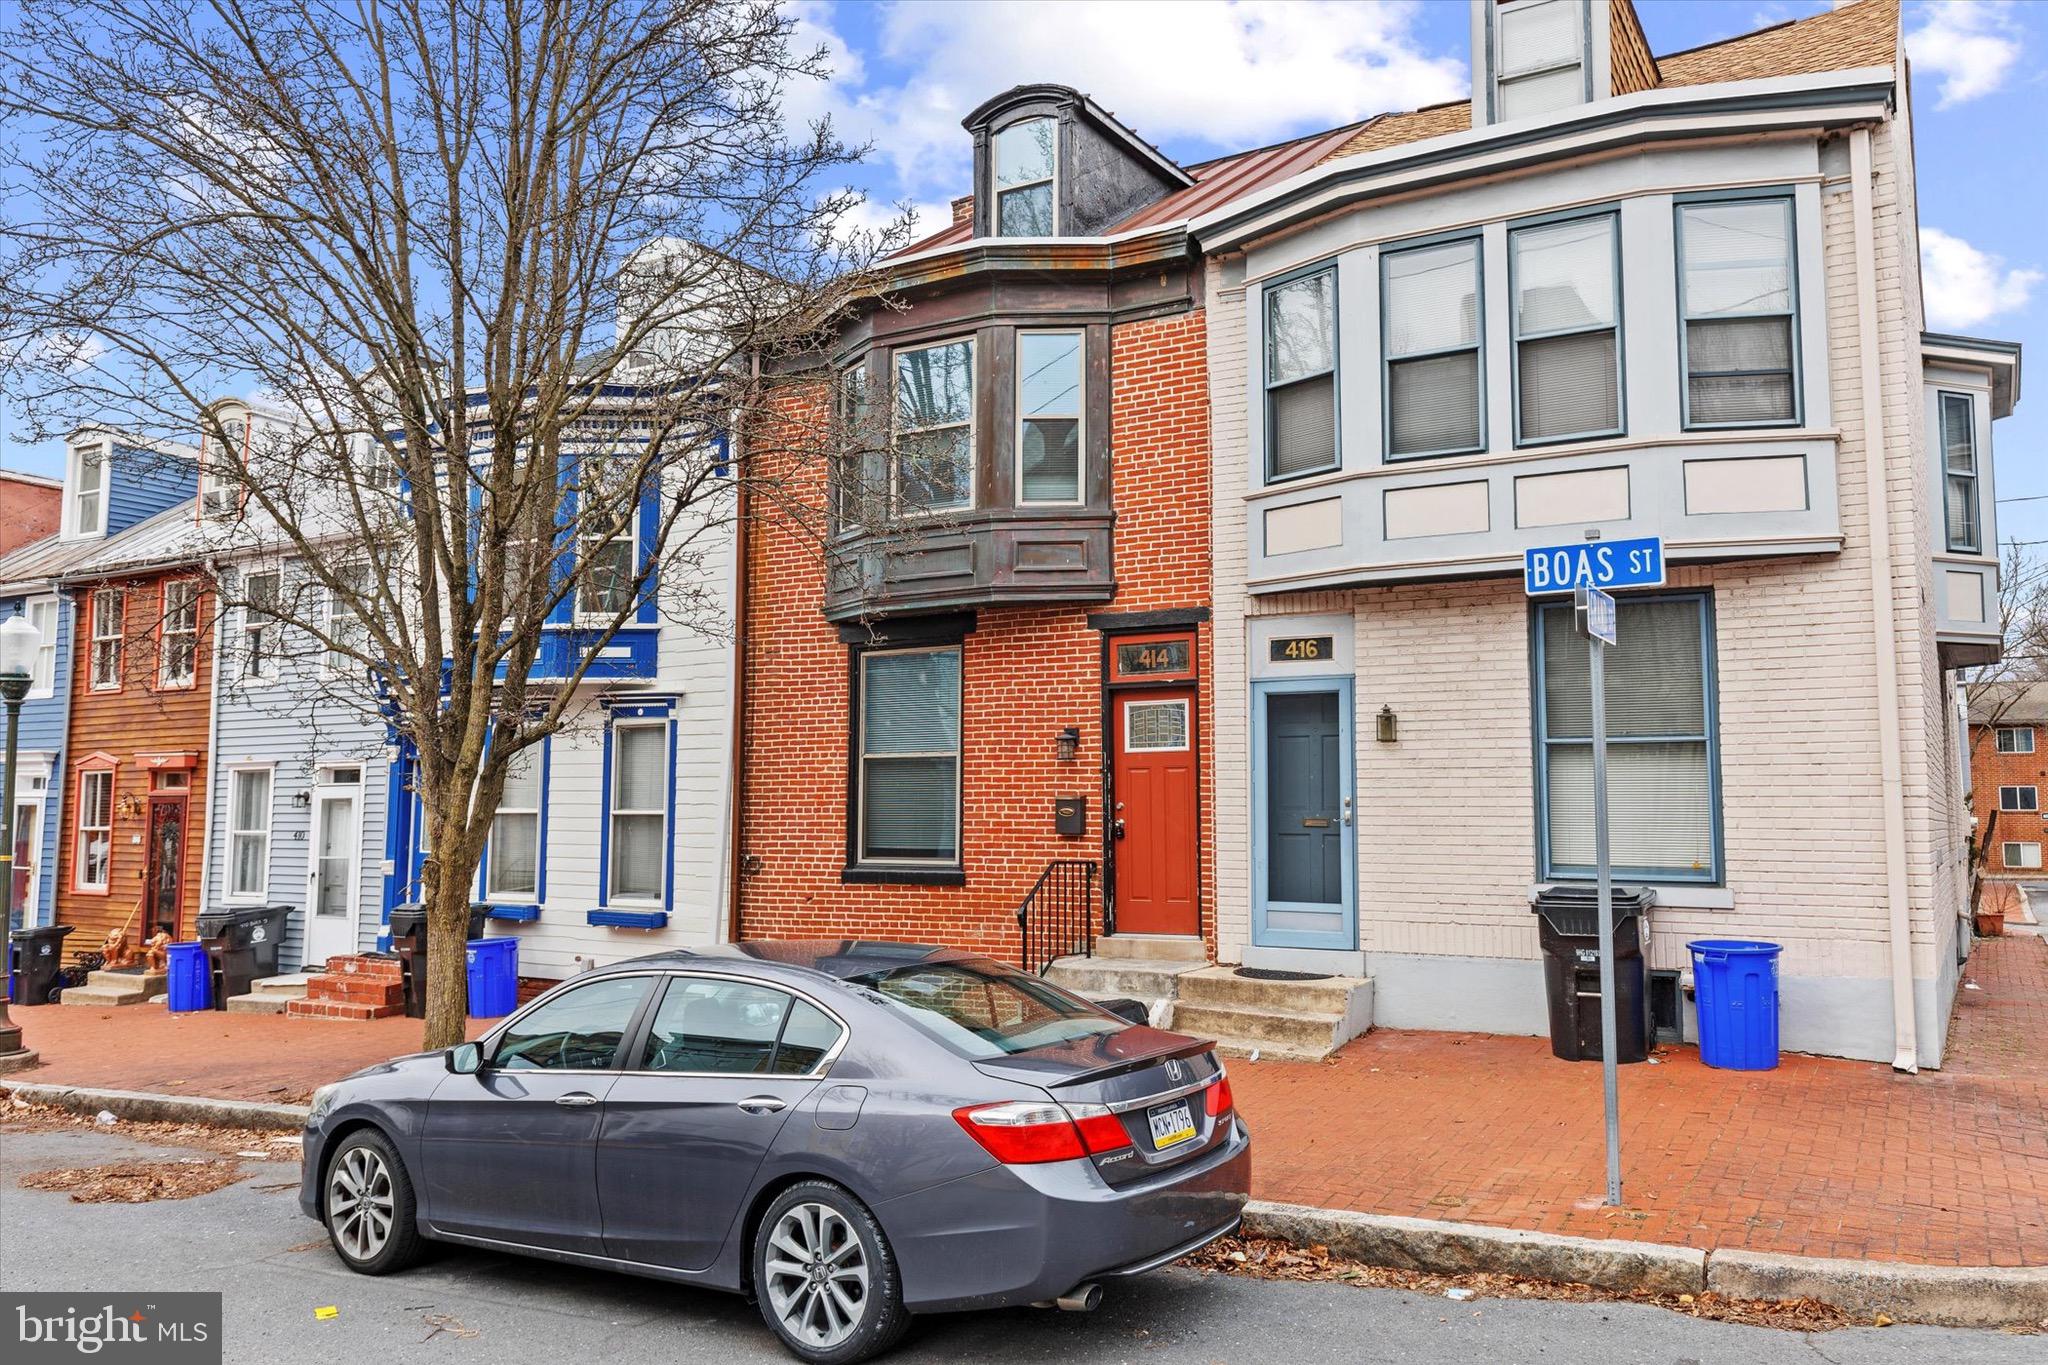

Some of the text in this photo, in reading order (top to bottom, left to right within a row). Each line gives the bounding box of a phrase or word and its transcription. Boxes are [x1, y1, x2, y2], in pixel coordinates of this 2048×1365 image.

[1533, 547, 1653, 587] BOAS ST
[1138, 649, 1168, 669] 414
[1285, 639, 1318, 659] 416
[1099, 1150, 1134, 1166] Accord
